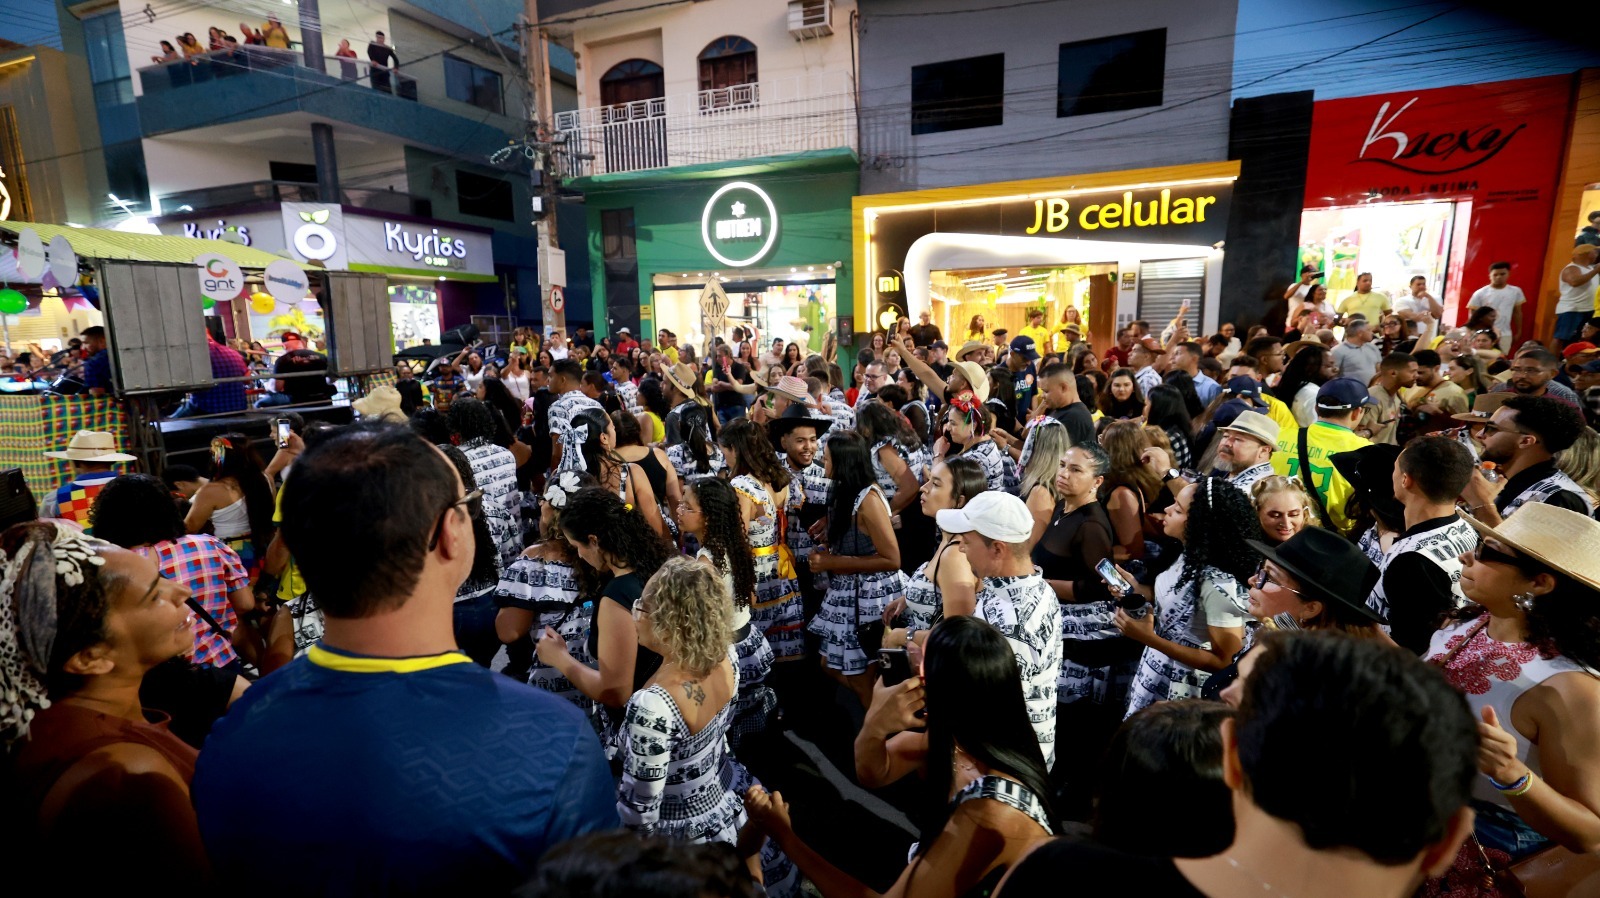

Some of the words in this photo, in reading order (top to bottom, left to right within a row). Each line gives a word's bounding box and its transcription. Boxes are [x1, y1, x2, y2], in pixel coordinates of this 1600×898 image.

[1368, 185, 1411, 198] MODA
[1026, 198, 1070, 235] JB
[1078, 188, 1216, 231] celular
[384, 222, 467, 261] Kyrios
[204, 278, 236, 292] gnt
[1278, 440, 1323, 459] ALISON
